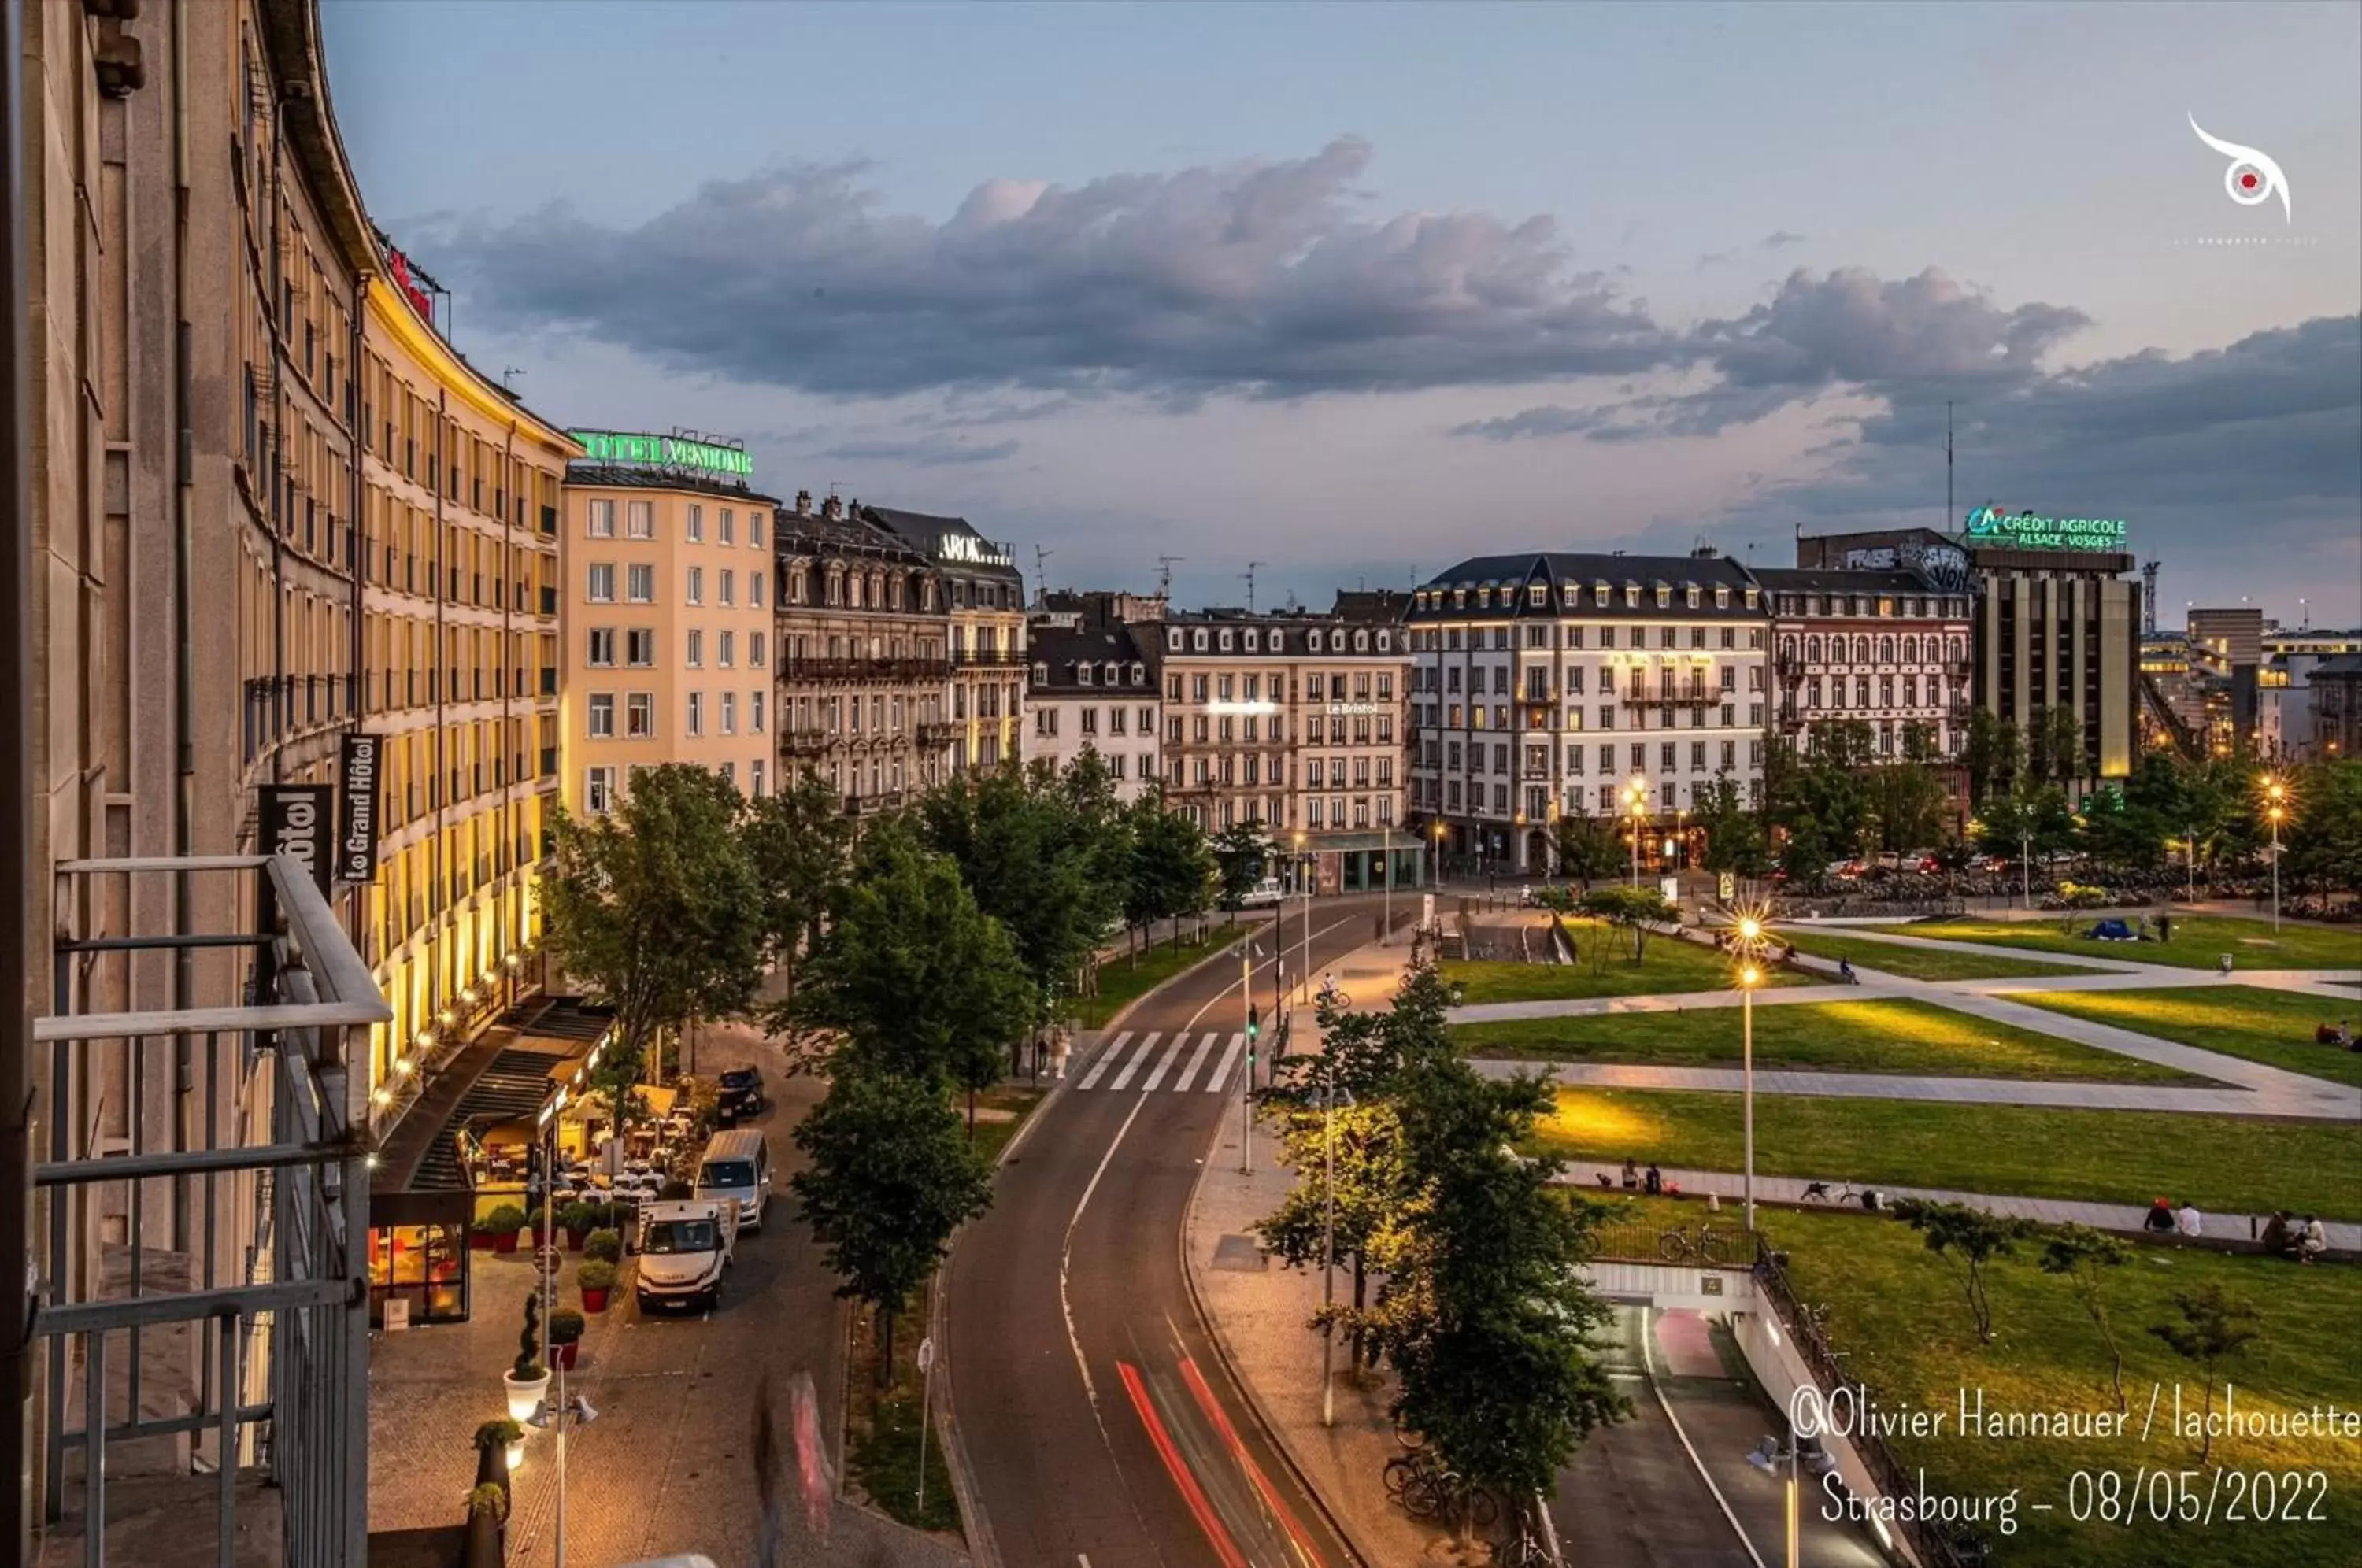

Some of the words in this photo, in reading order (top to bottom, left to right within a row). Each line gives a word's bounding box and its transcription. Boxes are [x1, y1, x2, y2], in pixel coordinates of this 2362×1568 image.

[668, 438, 753, 474] VENDOME
[2003, 514, 2054, 532] CRÉDIT
[2059, 519, 2126, 534] AGRICOLE
[2018, 533, 2063, 545] ALSACE
[2068, 534, 2112, 547] VOSGES
[349, 738, 374, 790] Hôtel
[276, 793, 316, 871] ôtel
[346, 793, 371, 853] Grand
[345, 855, 368, 878] Le
